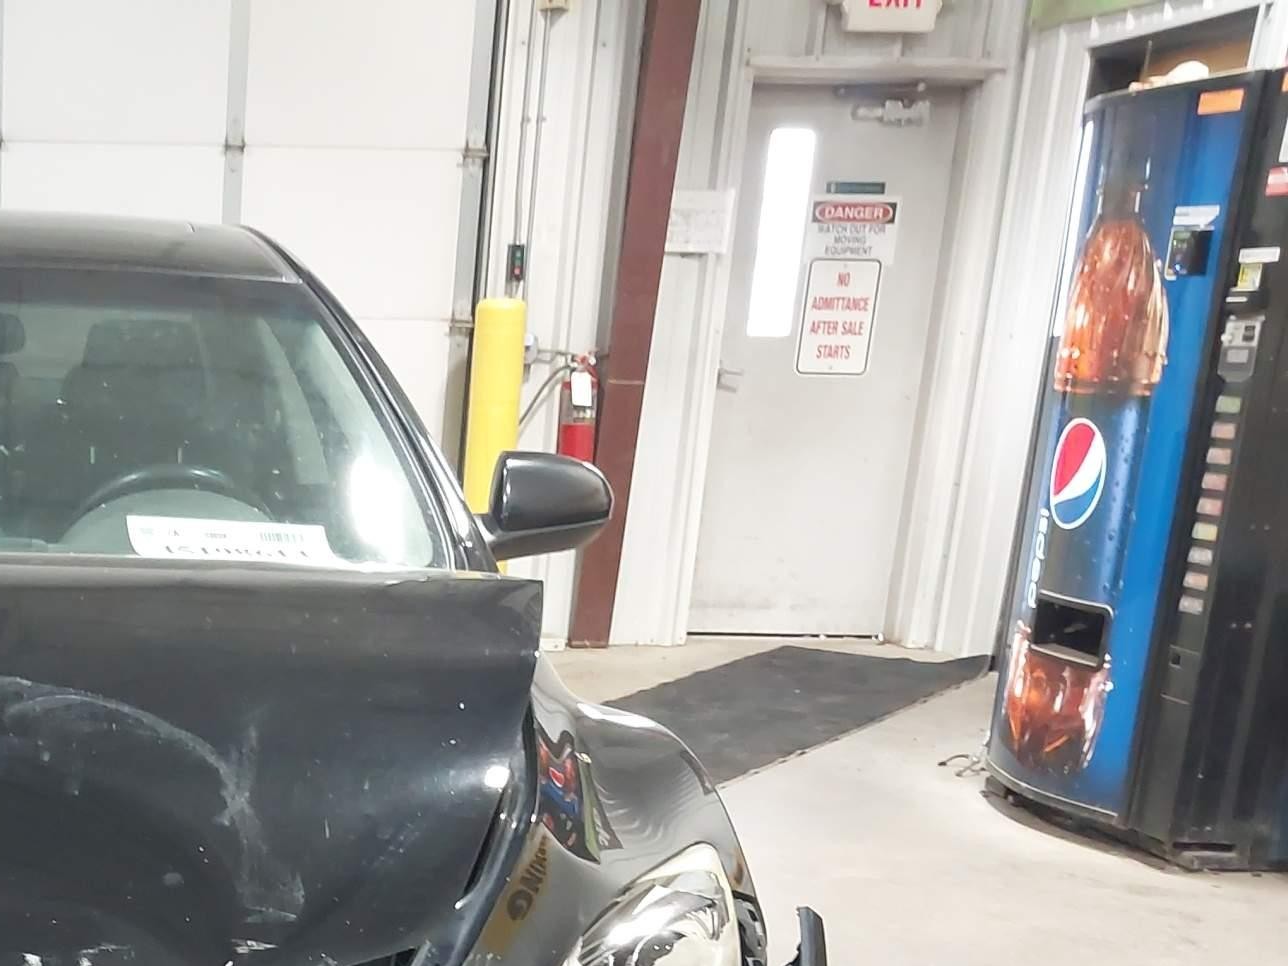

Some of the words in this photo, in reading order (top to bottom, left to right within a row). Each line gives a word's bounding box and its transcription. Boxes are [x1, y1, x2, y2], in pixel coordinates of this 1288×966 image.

[824, 206, 884, 219] DANGER
[850, 225, 866, 234] OUT
[869, 225, 886, 235] FOR
[834, 236, 866, 244] MOVING
[825, 246, 872, 256] EQUIPMENT
[837, 272, 851, 288] NO
[812, 297, 870, 312] ADMITTANCE
[810, 320, 839, 336] AFTER
[842, 321, 864, 336] SALE
[816, 344, 851, 360] STARTS
[1027, 508, 1050, 609] pepsi
